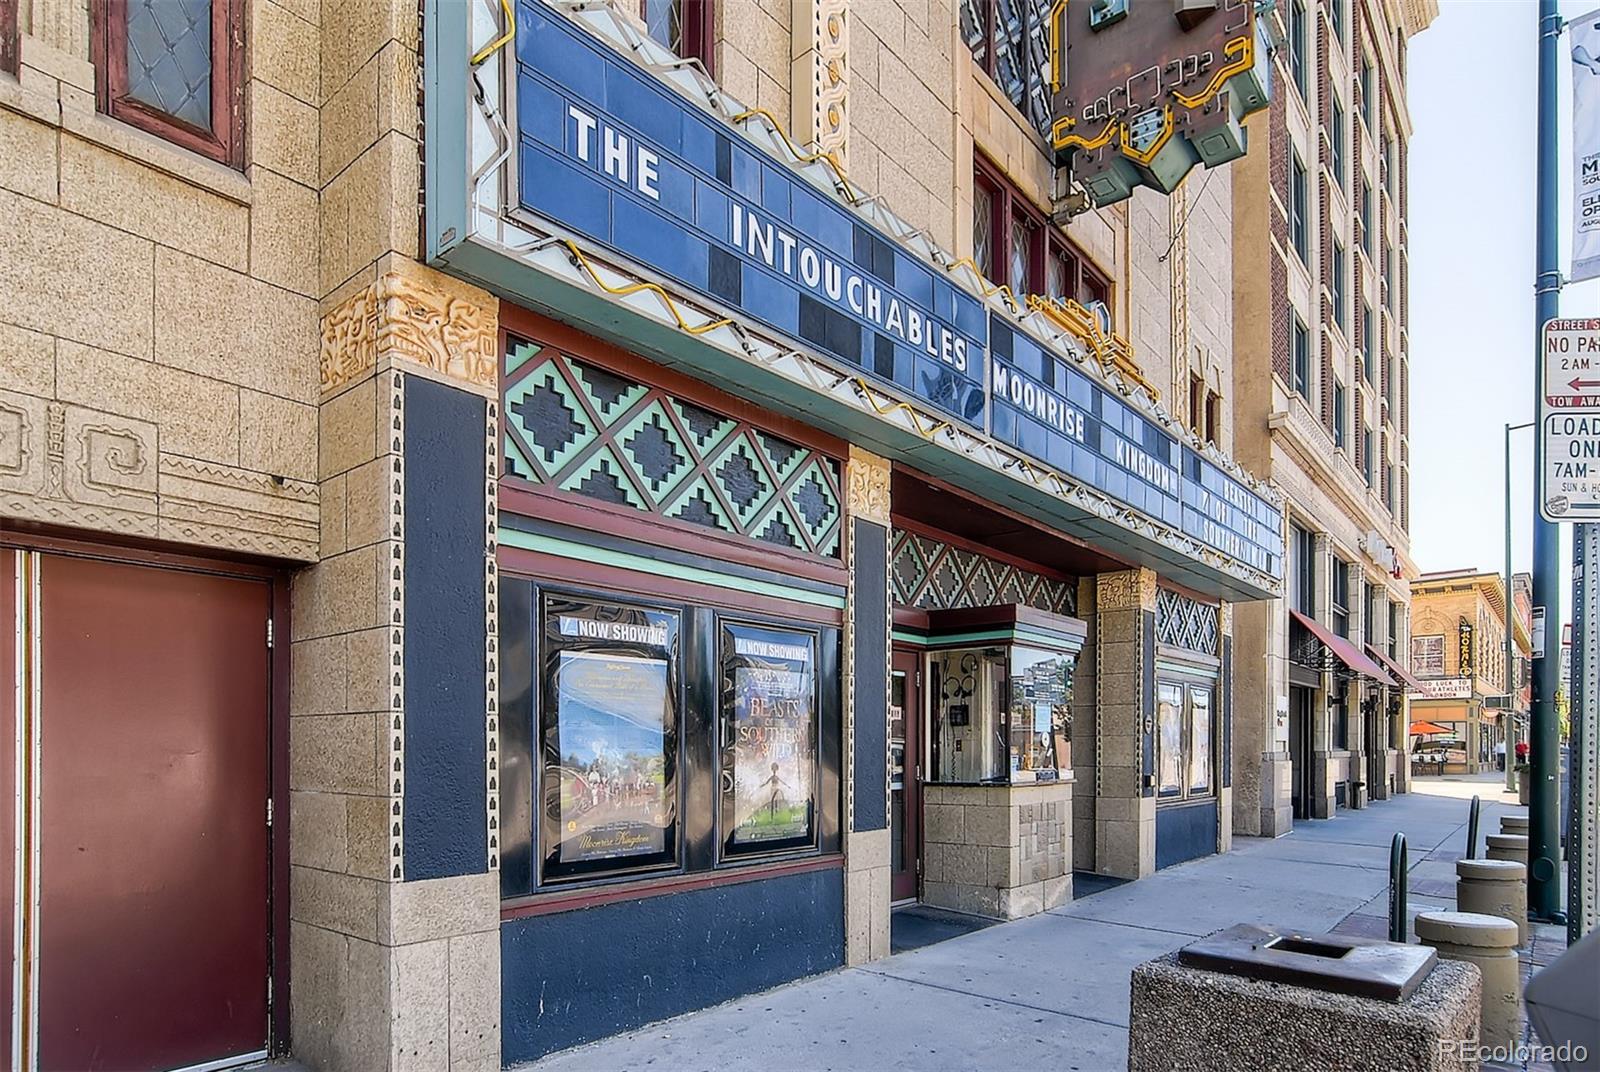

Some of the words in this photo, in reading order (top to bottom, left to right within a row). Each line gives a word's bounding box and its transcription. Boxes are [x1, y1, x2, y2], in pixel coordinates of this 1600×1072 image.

[569, 106, 660, 200] THE
[733, 204, 967, 372] INTOUCHABLES
[1551, 320, 1588, 330] STREET
[1548, 337, 1569, 353] NO
[1578, 337, 1600, 353] PA
[1551, 396, 1573, 407] TOW
[993, 360, 1085, 443] MOONRISE
[1116, 437, 1169, 492] KINGDOM
[1552, 418, 1600, 435] LOAD
[1569, 440, 1600, 458] ON
[1561, 482, 1577, 492] SUN
[1580, 482, 1587, 492] &
[579, 620, 608, 640] NOW
[612, 624, 666, 646] SHOWING
[747, 641, 767, 656] NOW
[769, 644, 808, 661] SHOWING
[750, 697, 800, 718] BEASTS
[579, 833, 613, 849] Moonrise
[615, 831, 649, 847] Kingdom
